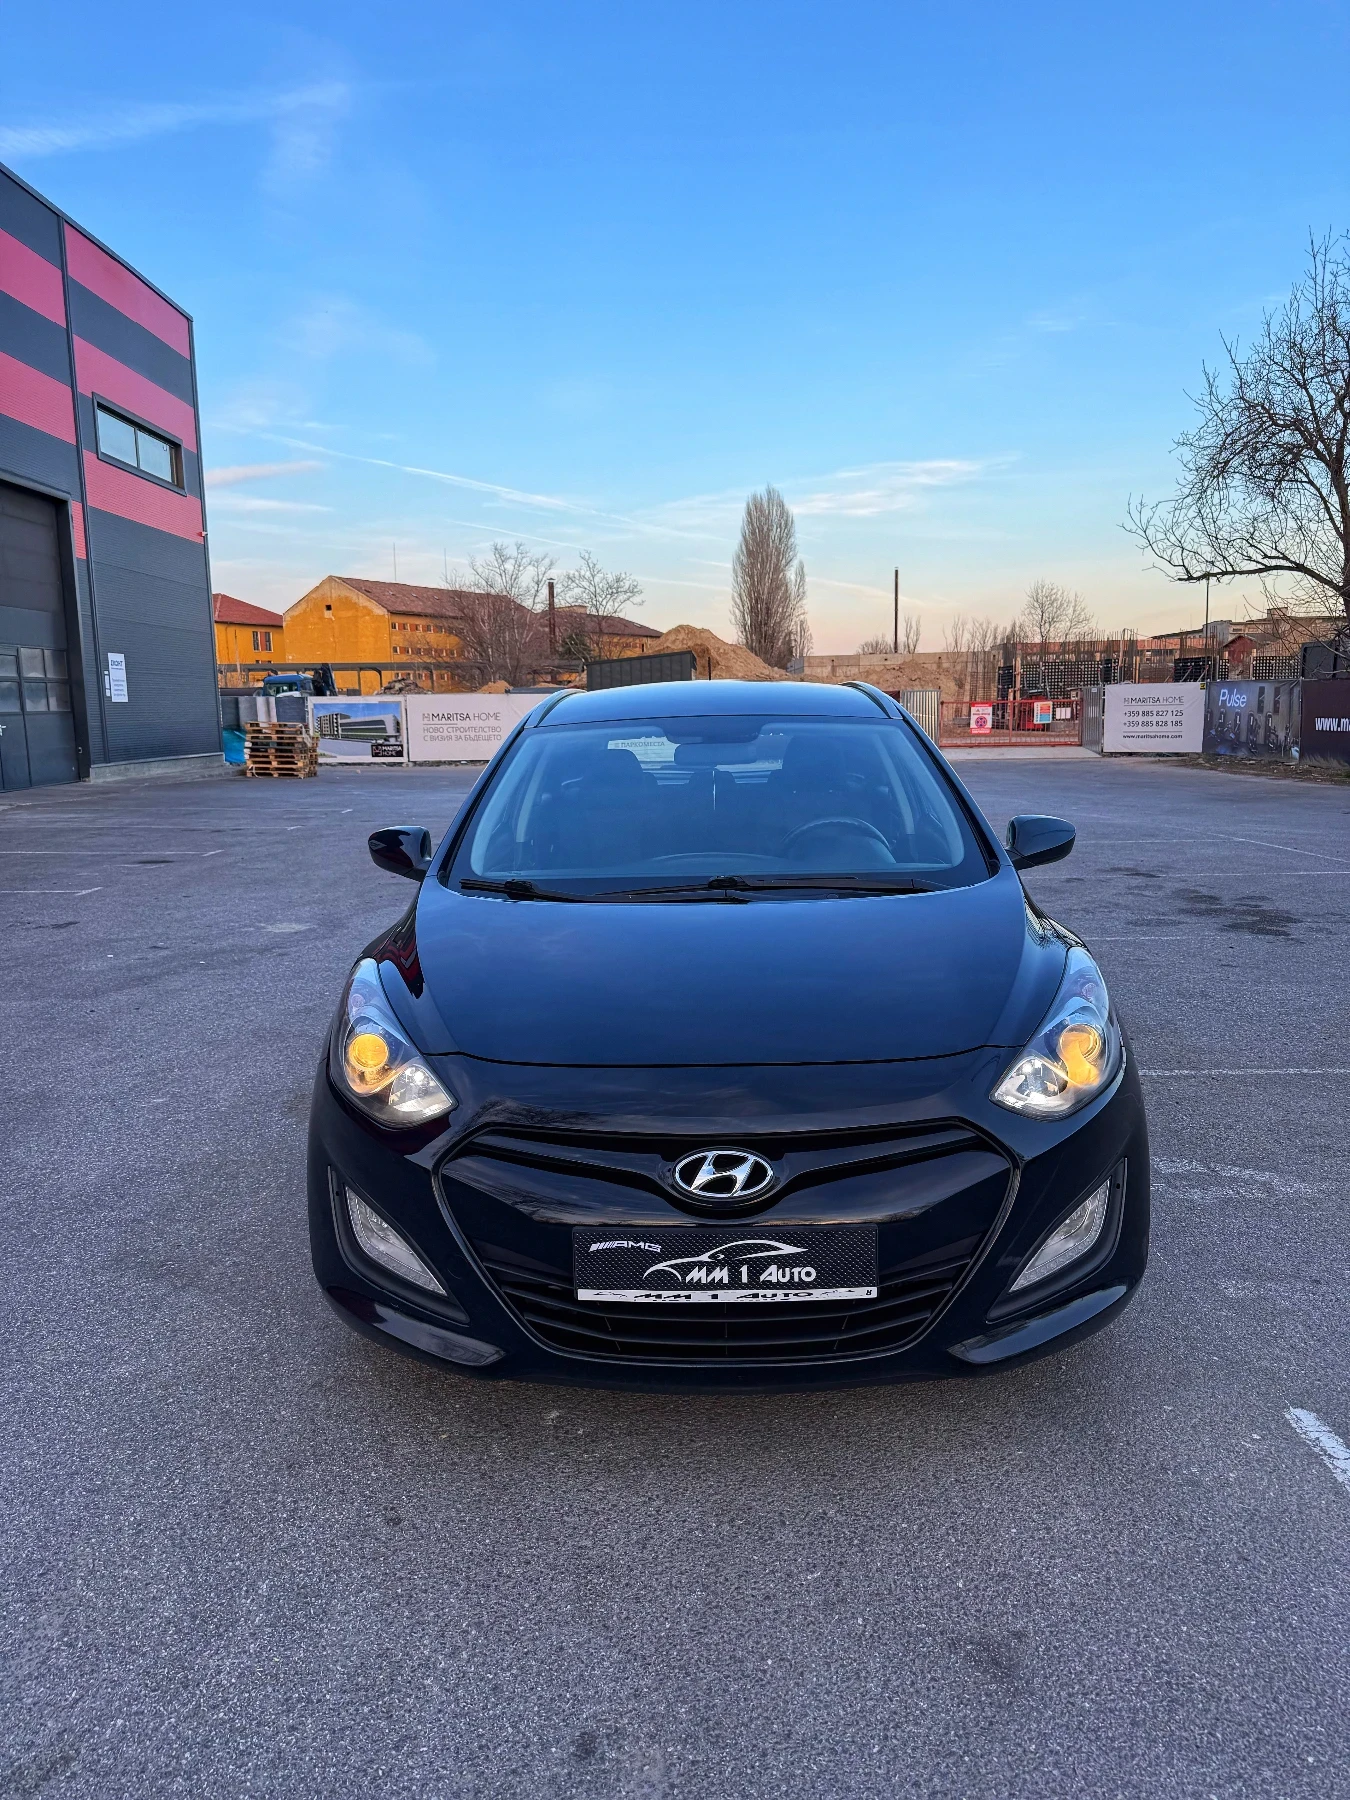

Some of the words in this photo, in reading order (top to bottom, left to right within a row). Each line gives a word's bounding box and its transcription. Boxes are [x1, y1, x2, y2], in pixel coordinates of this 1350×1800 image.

[1130, 696, 1161, 704] MARITSA
[1162, 695, 1185, 704] HOME
[1218, 688, 1247, 708] Pulse
[431, 712, 472, 722] MARITSA
[473, 712, 501, 721] HOME
[1155, 709, 1169, 717] 827
[1170, 709, 1184, 717] 125
[1170, 719, 1183, 727] 185
[1315, 718, 1350, 732] www.m
[423, 726, 445, 734] НОВО
[445, 725, 502, 734] СТРОИТЕЛСТВО
[429, 734, 453, 742] ВИЗИЯ
[454, 734, 464, 742] ЗА
[464, 734, 502, 742] БЪДЕЩЕТО
[685, 1264, 729, 1284] MM
[738, 1264, 749, 1283] 1
